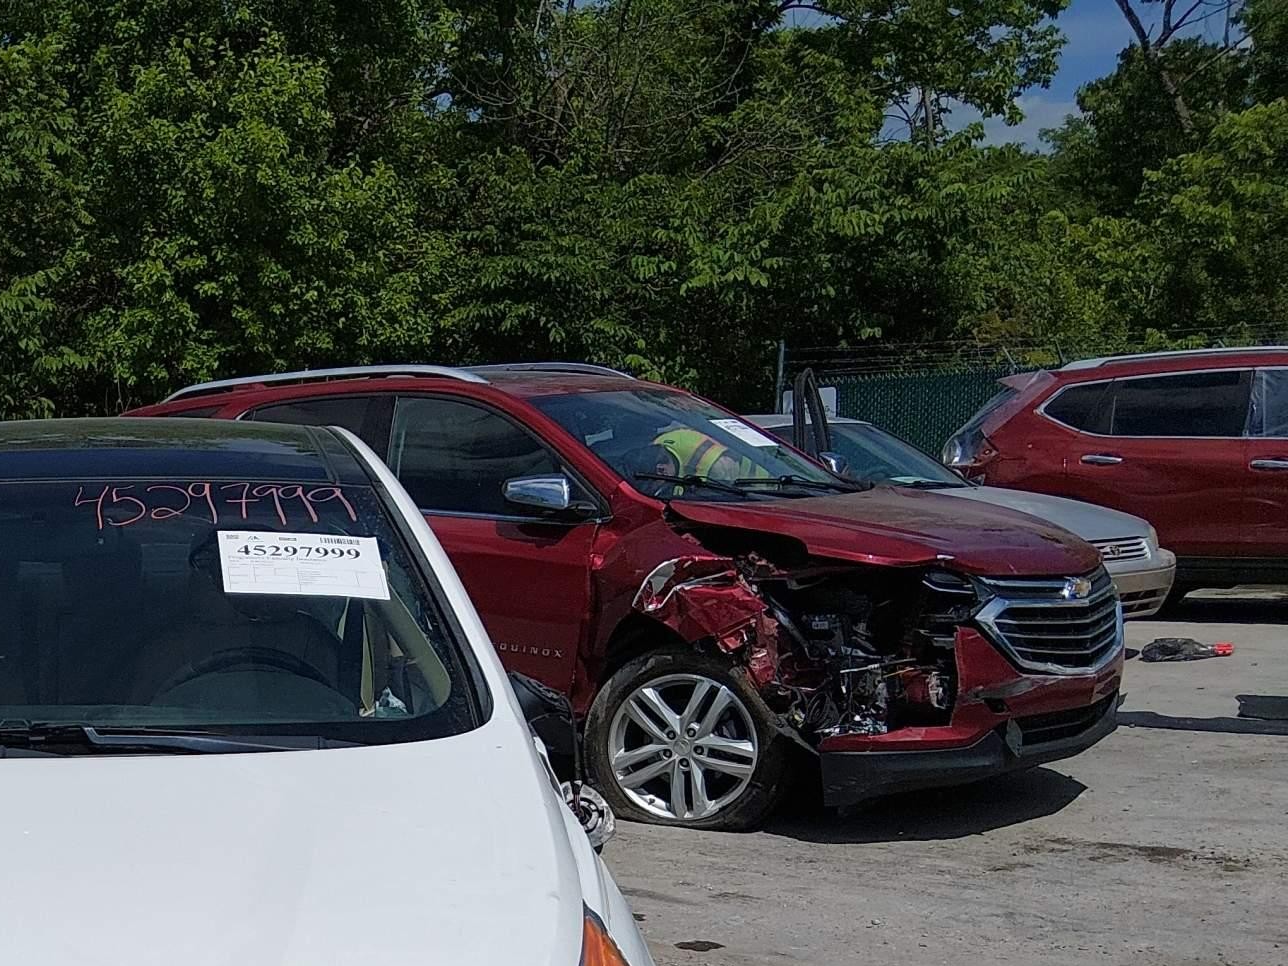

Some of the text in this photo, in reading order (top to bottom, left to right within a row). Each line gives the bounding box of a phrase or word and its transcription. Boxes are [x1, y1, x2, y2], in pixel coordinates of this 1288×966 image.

[75, 482, 357, 530] 45297999
[237, 544, 361, 560] 45297999
[493, 642, 563, 658] QUINOX
